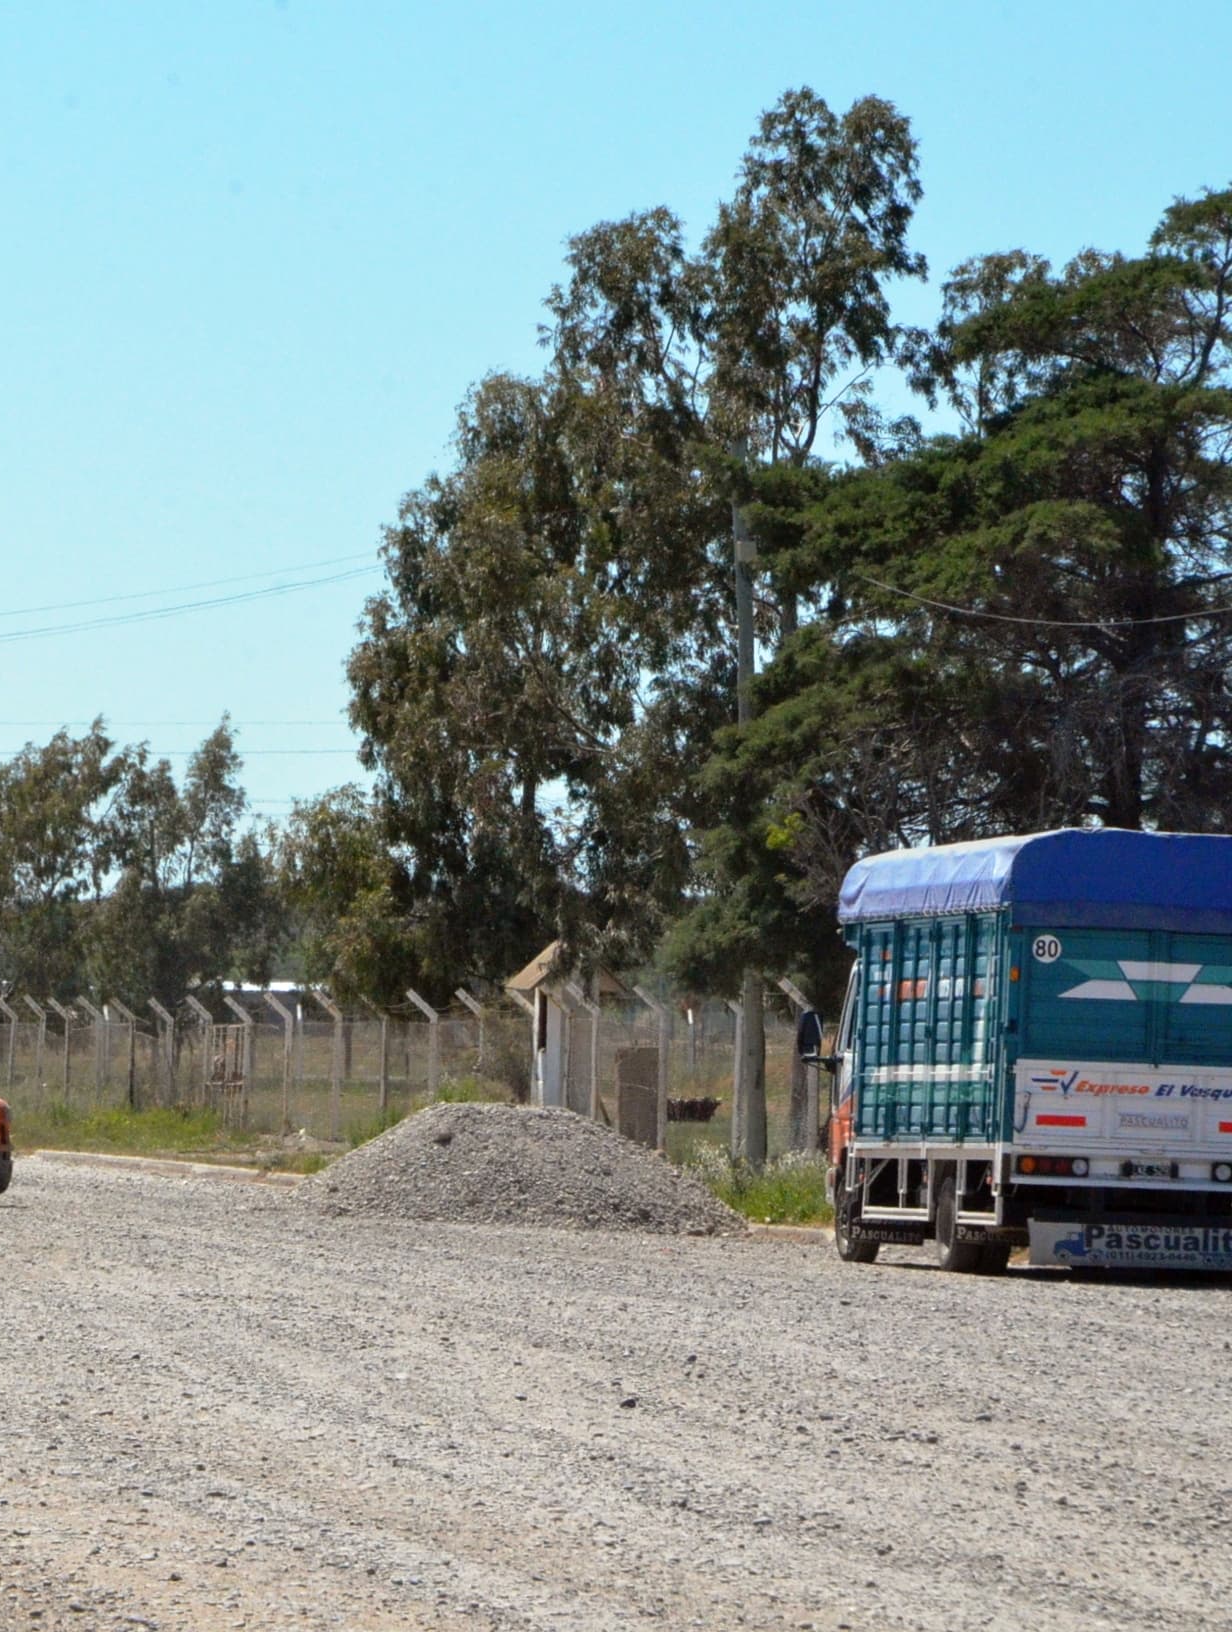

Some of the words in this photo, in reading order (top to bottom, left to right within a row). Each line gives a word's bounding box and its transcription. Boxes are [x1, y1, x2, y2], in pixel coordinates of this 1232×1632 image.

[1035, 940, 1058, 957] 80
[1075, 1080, 1150, 1096] Expreso
[1155, 1084, 1175, 1097] El
